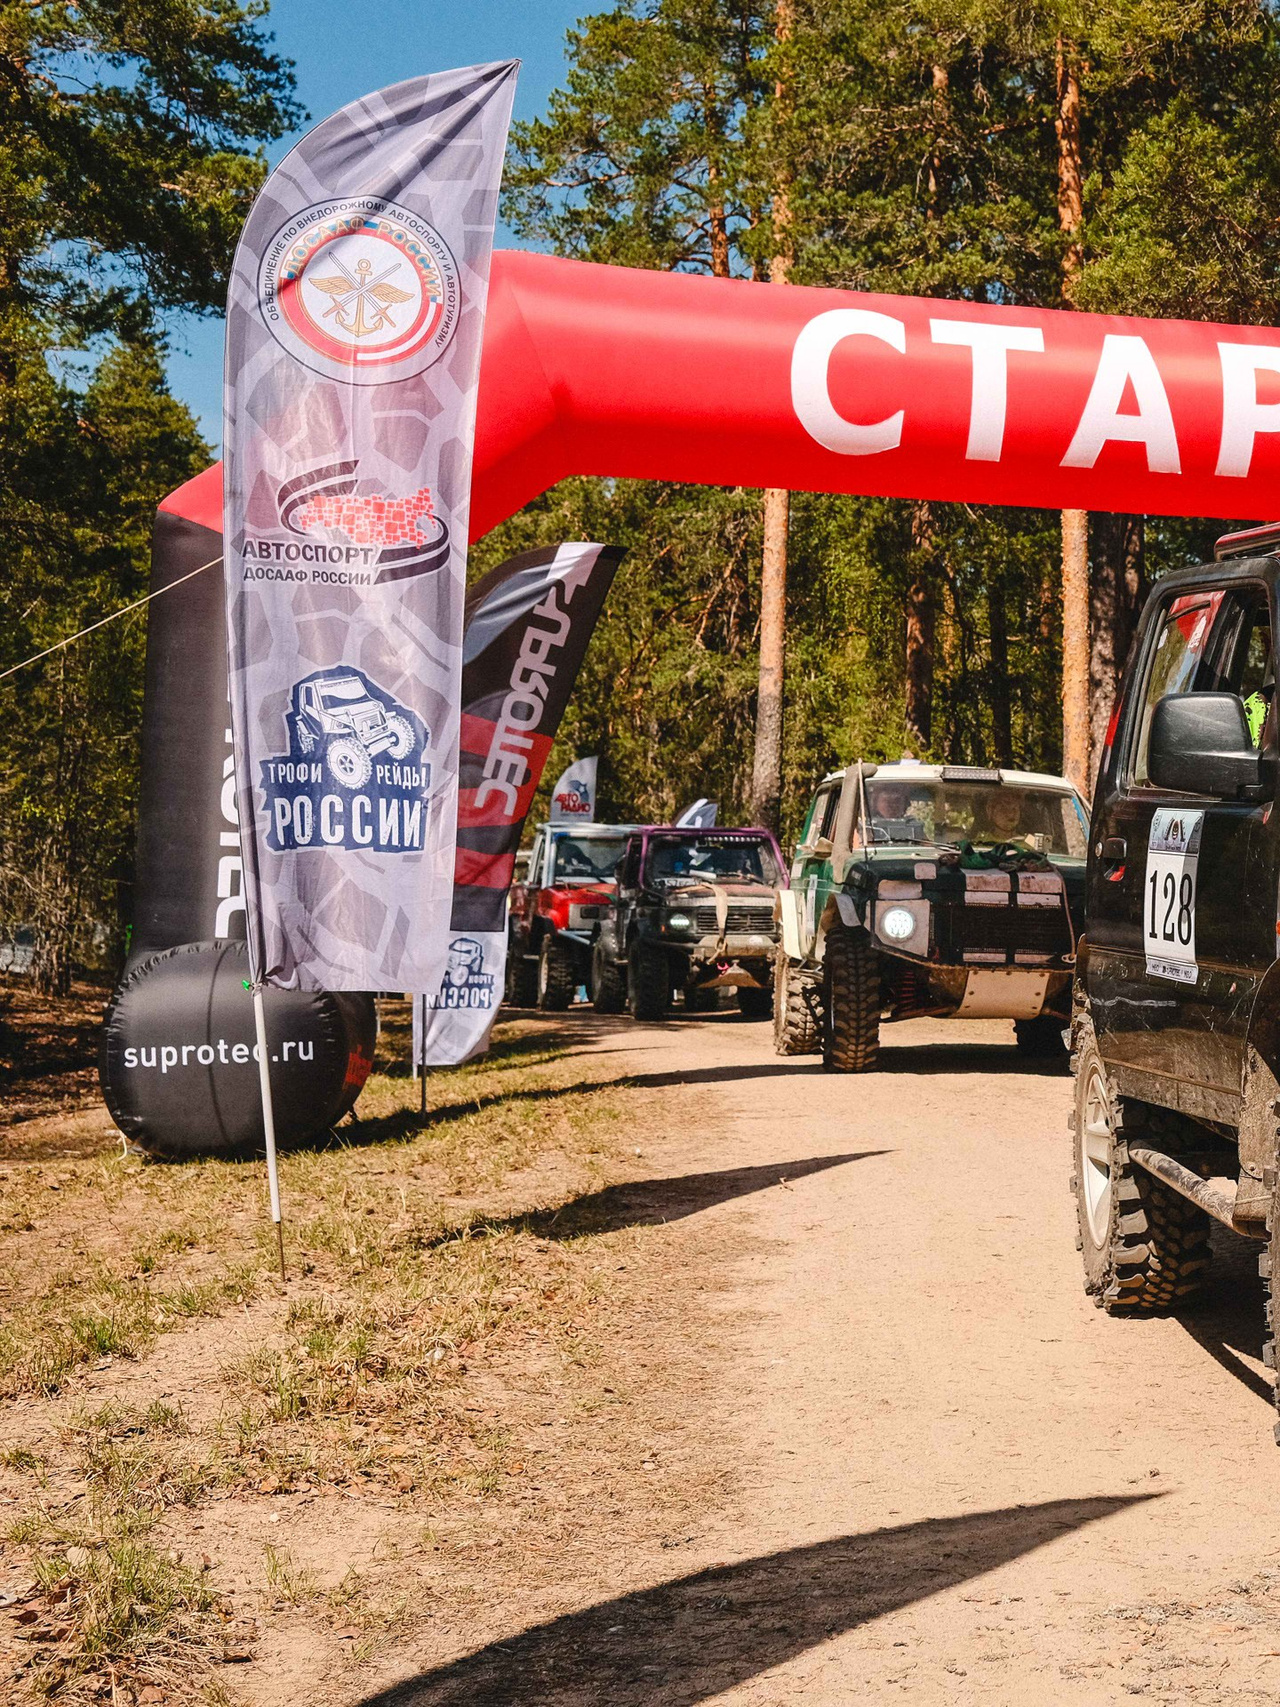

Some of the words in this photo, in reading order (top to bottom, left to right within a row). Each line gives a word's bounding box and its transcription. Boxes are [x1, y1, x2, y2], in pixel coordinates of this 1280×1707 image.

[282, 227, 298, 242] ПО
[296, 200, 387, 230] ВНЕДОРОЖНОМУ
[388, 209, 448, 262] АВТОСПОРТУ
[284, 216, 365, 275] ДОСААФ
[376, 220, 442, 297] РОССИИ
[442, 263, 452, 272] И
[264, 241, 287, 321] ОБЪЕДИНЕНИЕ
[434, 274, 456, 348] АВТОТУРИЗМУ
[242, 540, 374, 565] АВТОСПОРТ
[243, 566, 308, 583] ДОСААФ
[312, 570, 372, 586] РОССИИ
[268, 762, 322, 784] ТРОФИ
[376, 762, 427, 790] РЕЙДЫ
[274, 794, 422, 848] РОССИИ
[1149, 869, 1193, 946] 128
